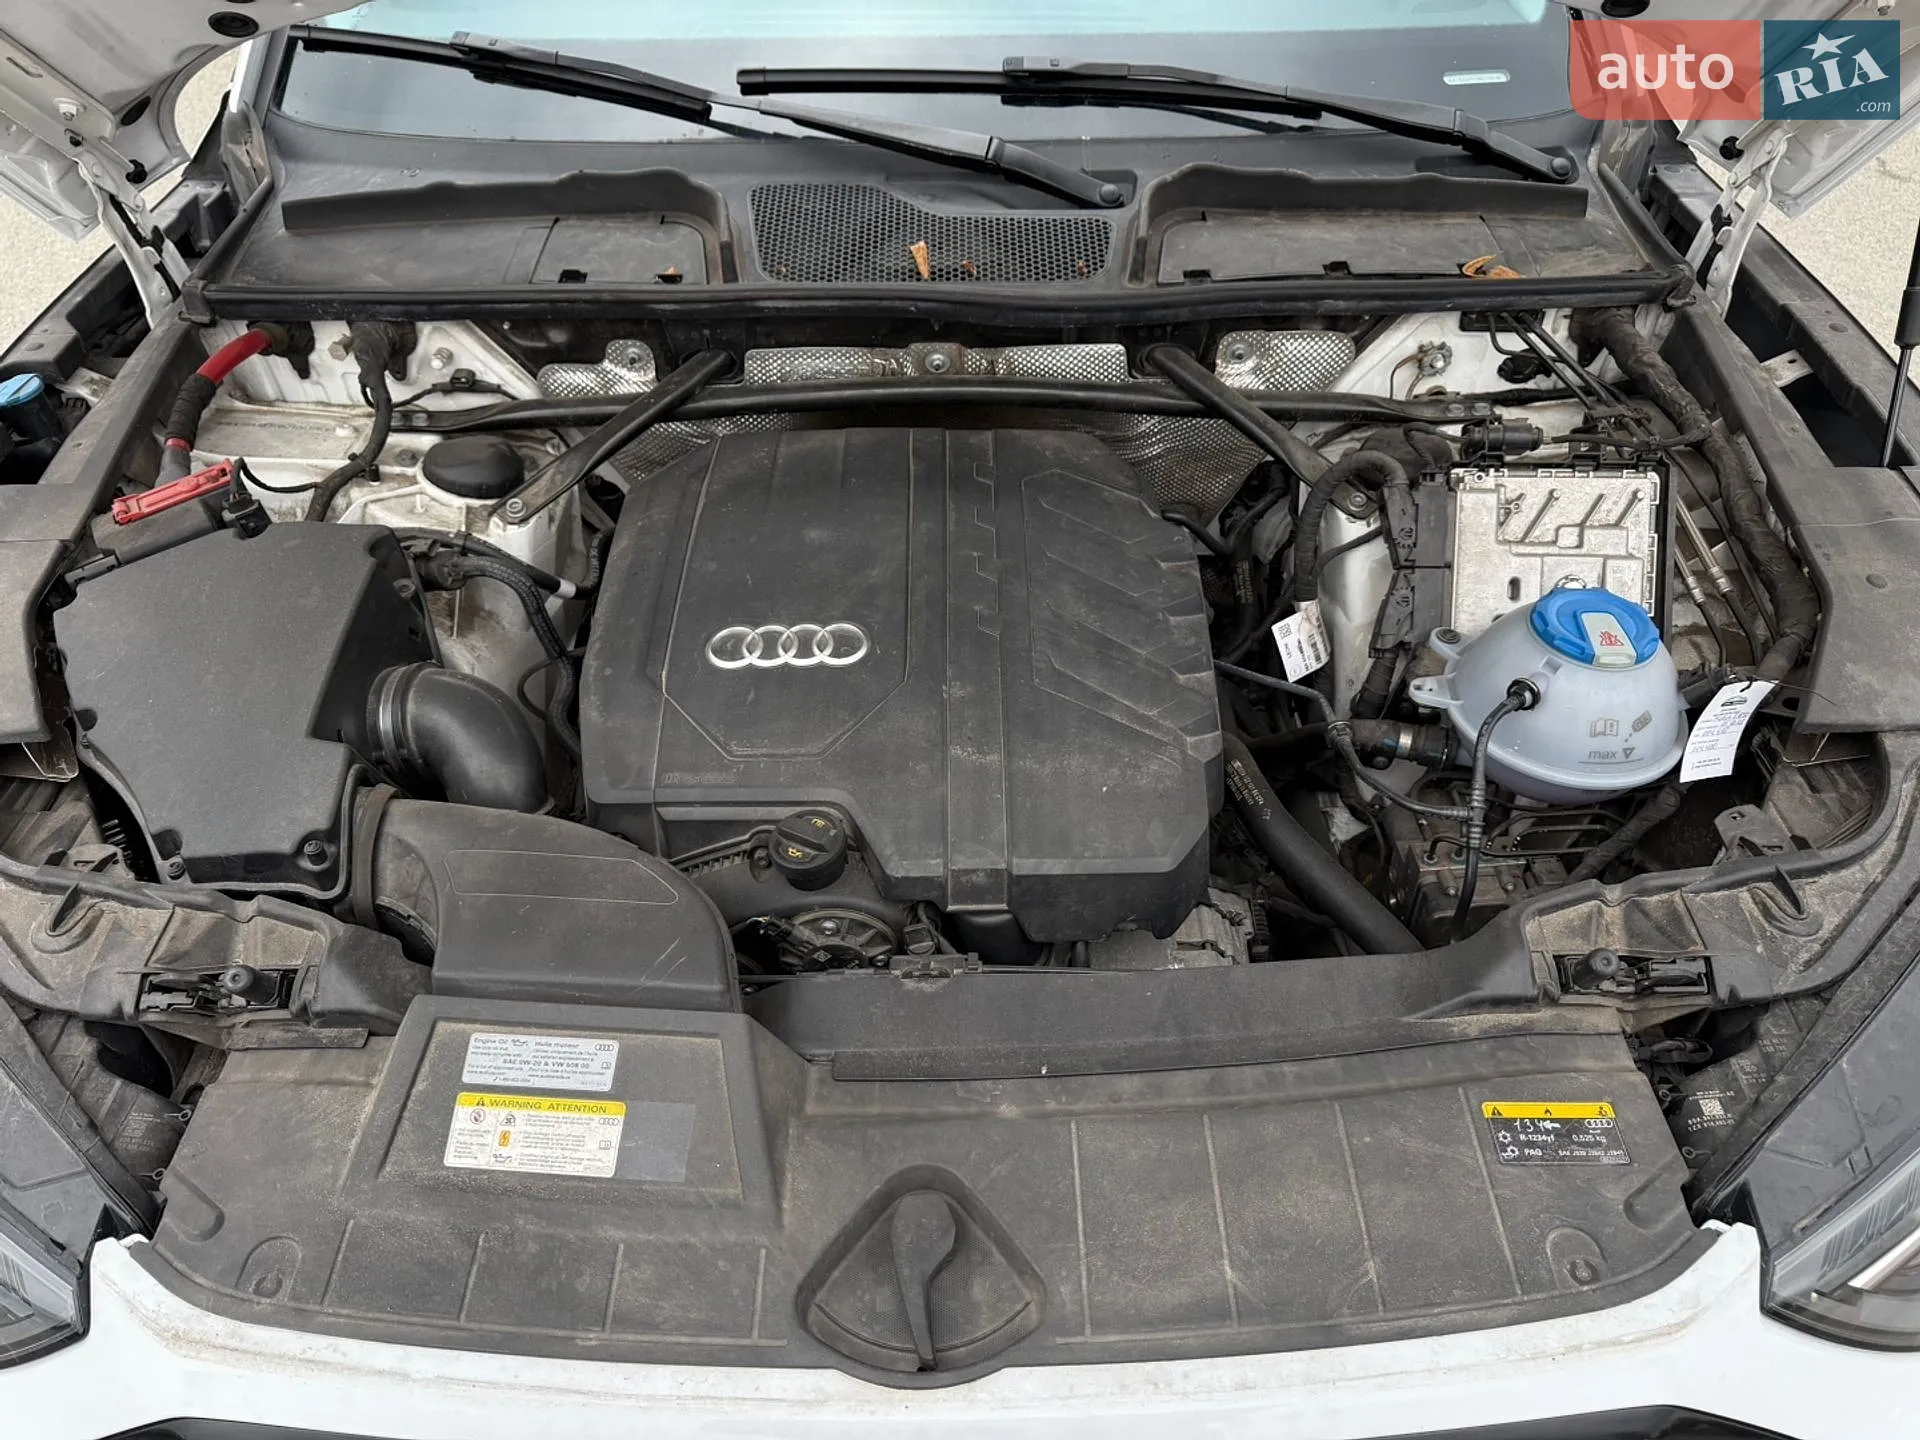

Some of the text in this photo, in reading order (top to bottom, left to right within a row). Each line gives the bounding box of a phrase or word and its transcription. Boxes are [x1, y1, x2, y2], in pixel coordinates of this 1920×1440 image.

[1588, 750, 1617, 760] max
[474, 1037, 496, 1046] Engine
[490, 1098, 607, 1113] WARNING ATTENTION
